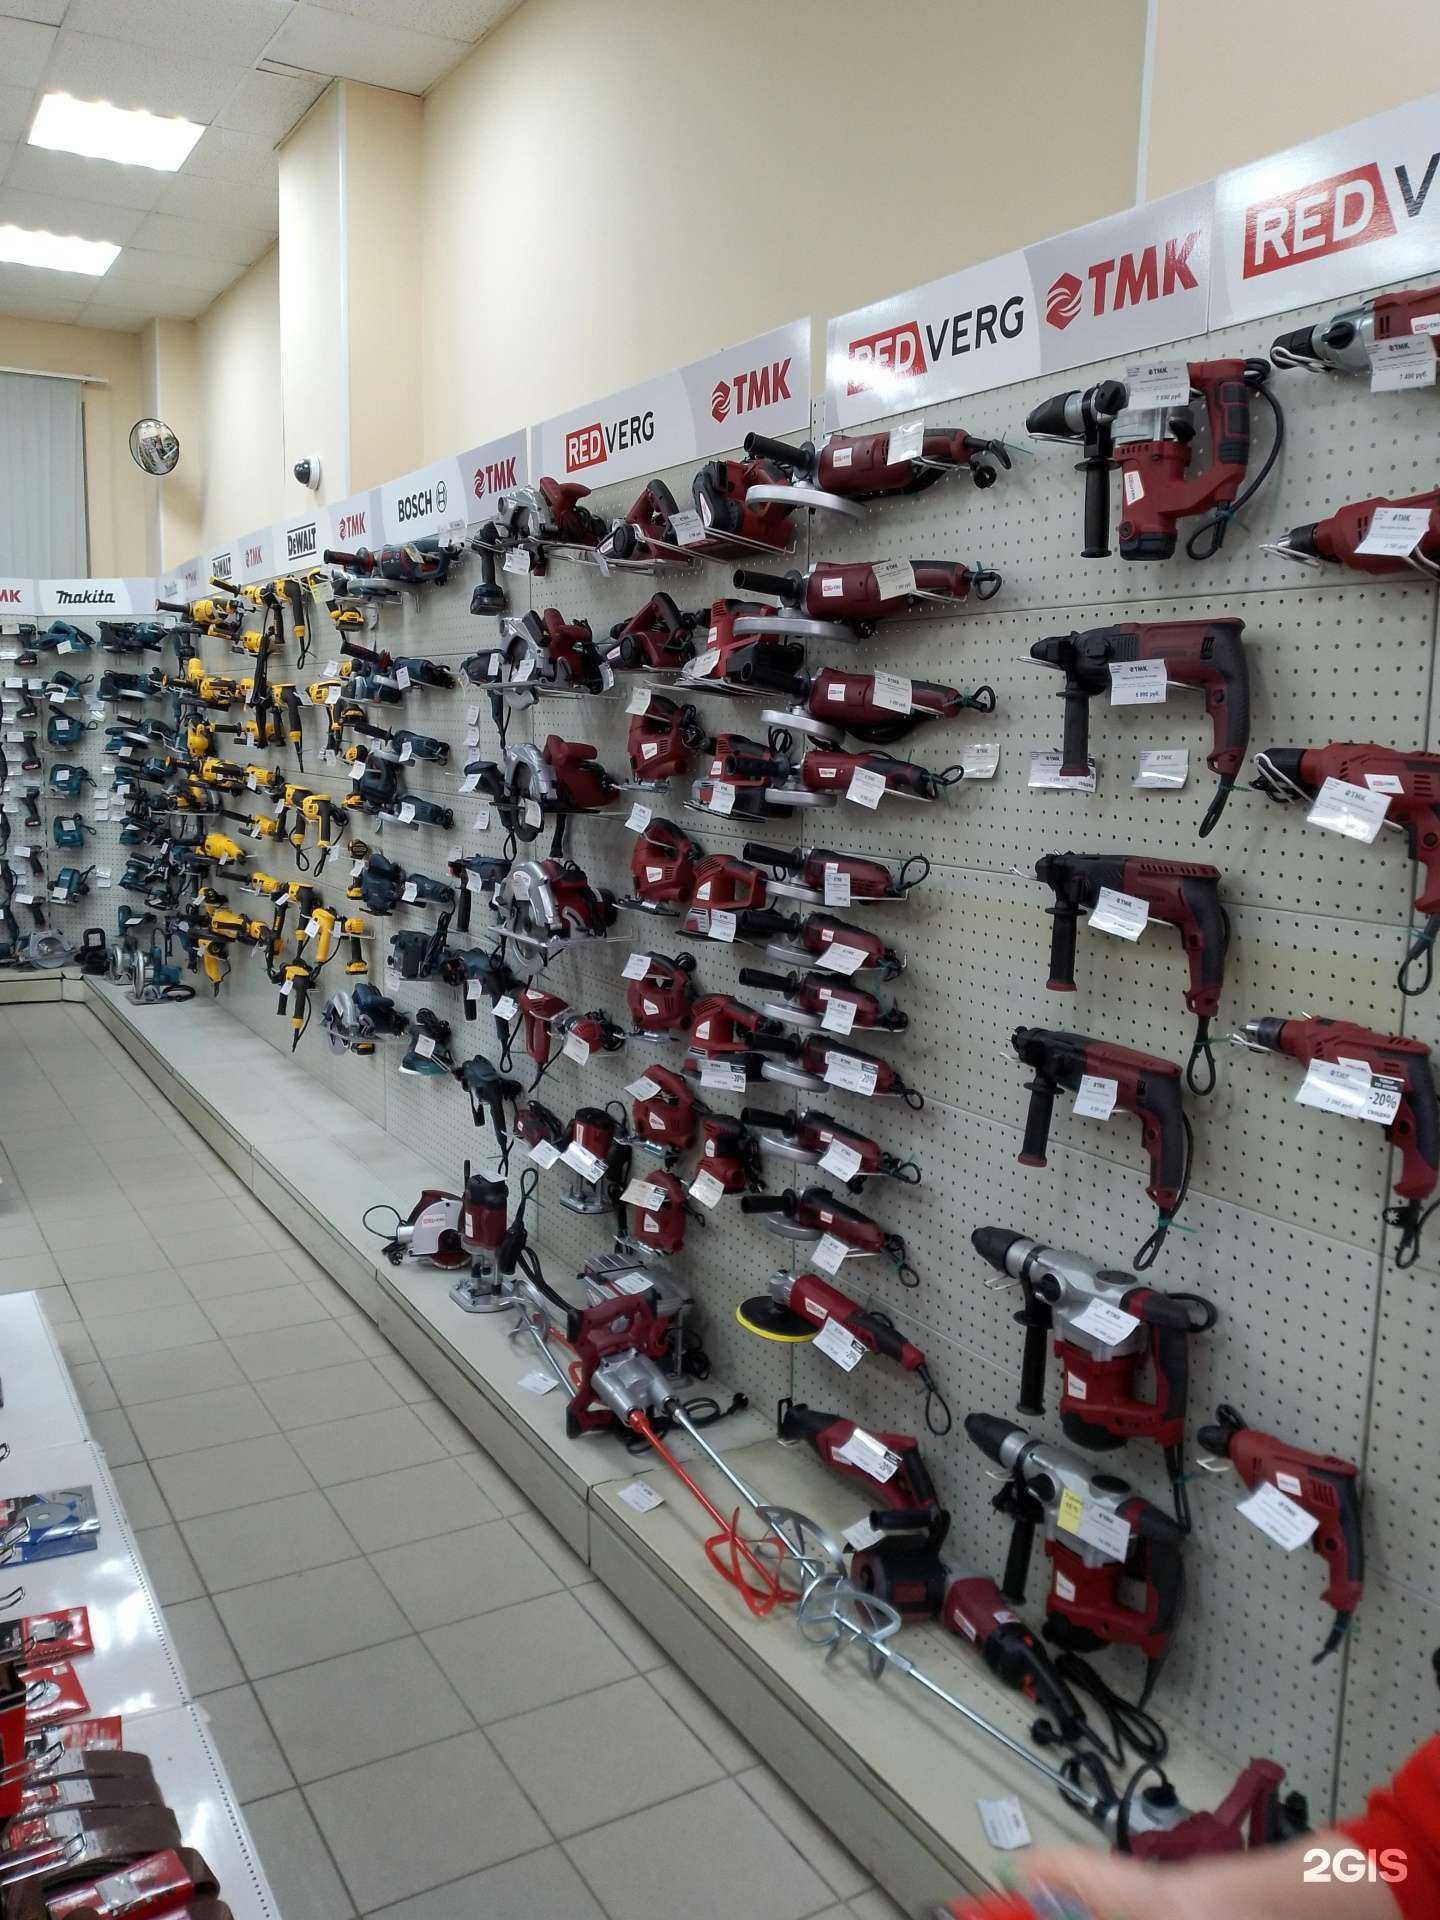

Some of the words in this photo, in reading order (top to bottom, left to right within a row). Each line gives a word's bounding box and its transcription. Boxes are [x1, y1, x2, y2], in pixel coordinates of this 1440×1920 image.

[1254, 152, 1440, 266] REDV
[1088, 230, 1201, 317] TMK
[733, 357, 792, 415] TMK
[568, 411, 655, 469] REDVERG
[485, 456, 517, 494] TMK
[347, 511, 366, 537] TMK
[397, 489, 433, 523] BOSCH
[0, 589, 22, 603] MK
[1369, 1092, 1397, 1109] -20%
